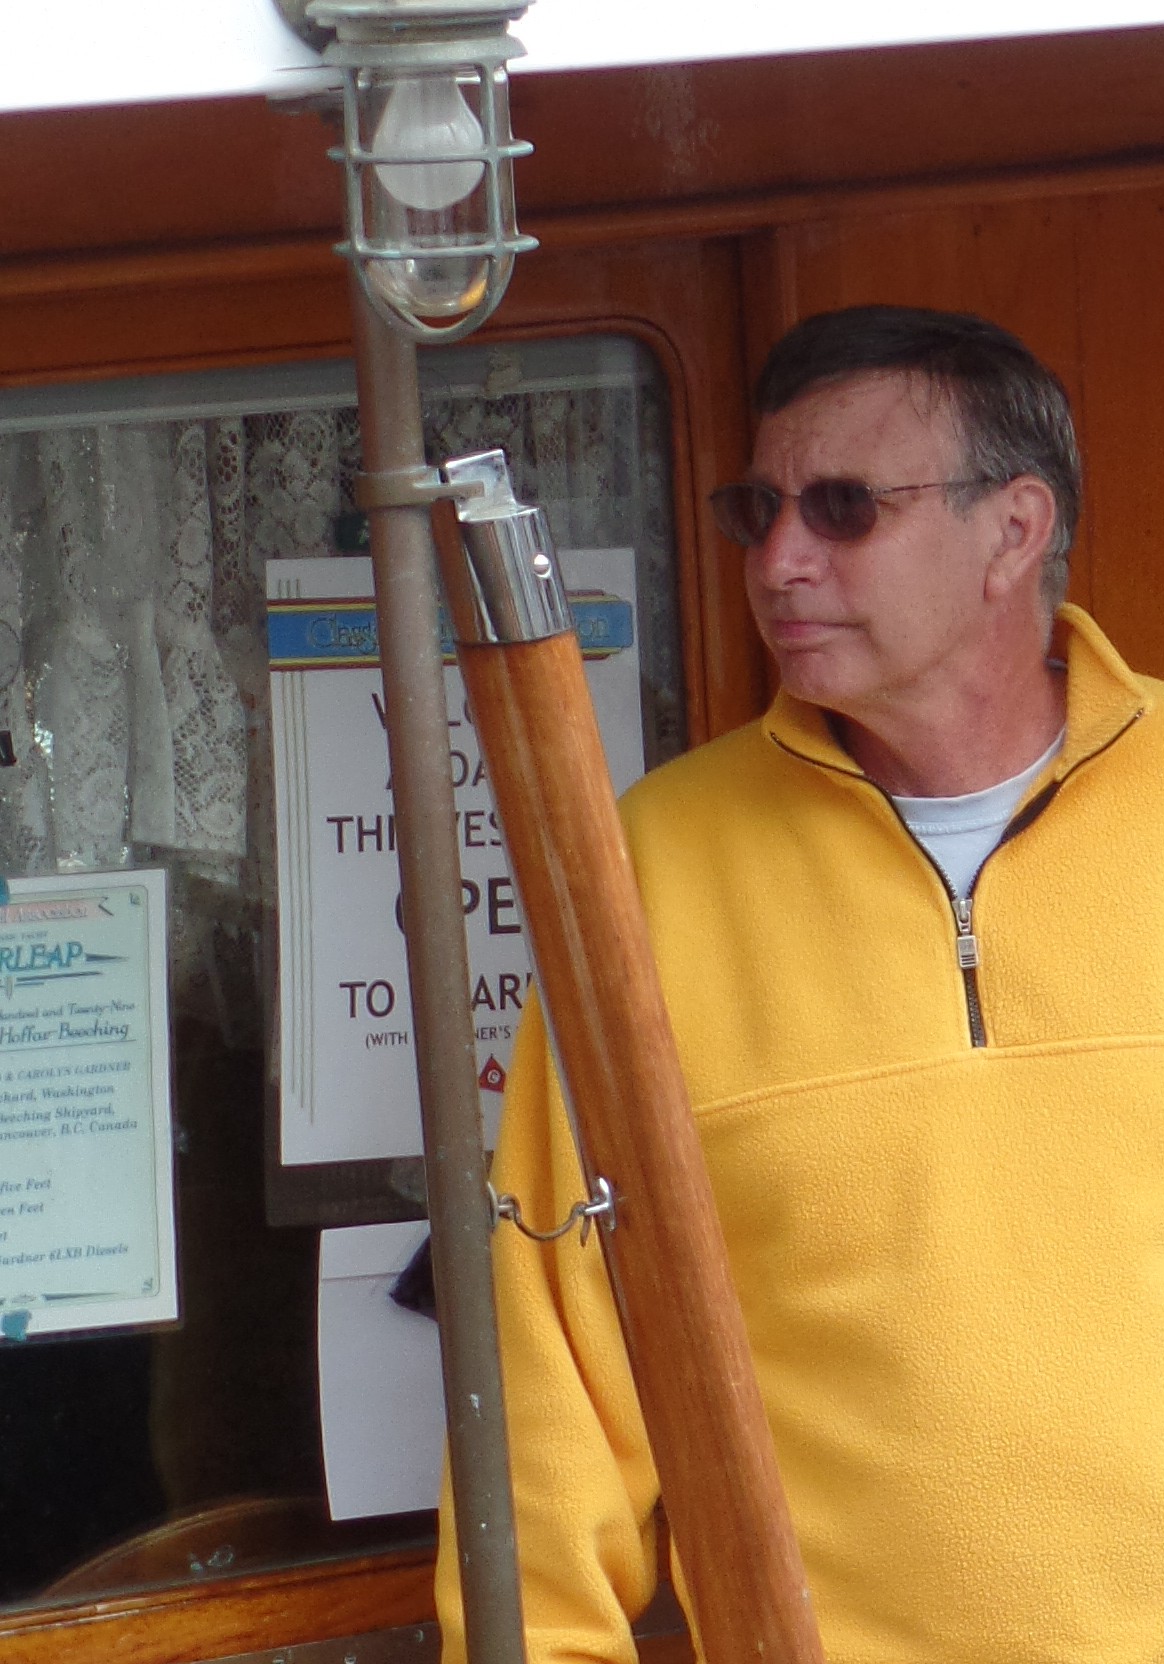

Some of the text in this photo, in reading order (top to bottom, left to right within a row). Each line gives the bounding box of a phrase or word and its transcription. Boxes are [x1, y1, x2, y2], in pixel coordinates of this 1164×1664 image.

[0, 941, 84, 972] RLEAP
[339, 979, 396, 1019] TO
[365, 1031, 408, 1049] (WITH
[0, 1085, 114, 1103] chard, Washington
[55, 1102, 115, 1120] Shipyard,
[0, 1128, 57, 1141] ancouver,
[89, 1119, 138, 1133] Canada
[26, 1178, 51, 1192] Feet
